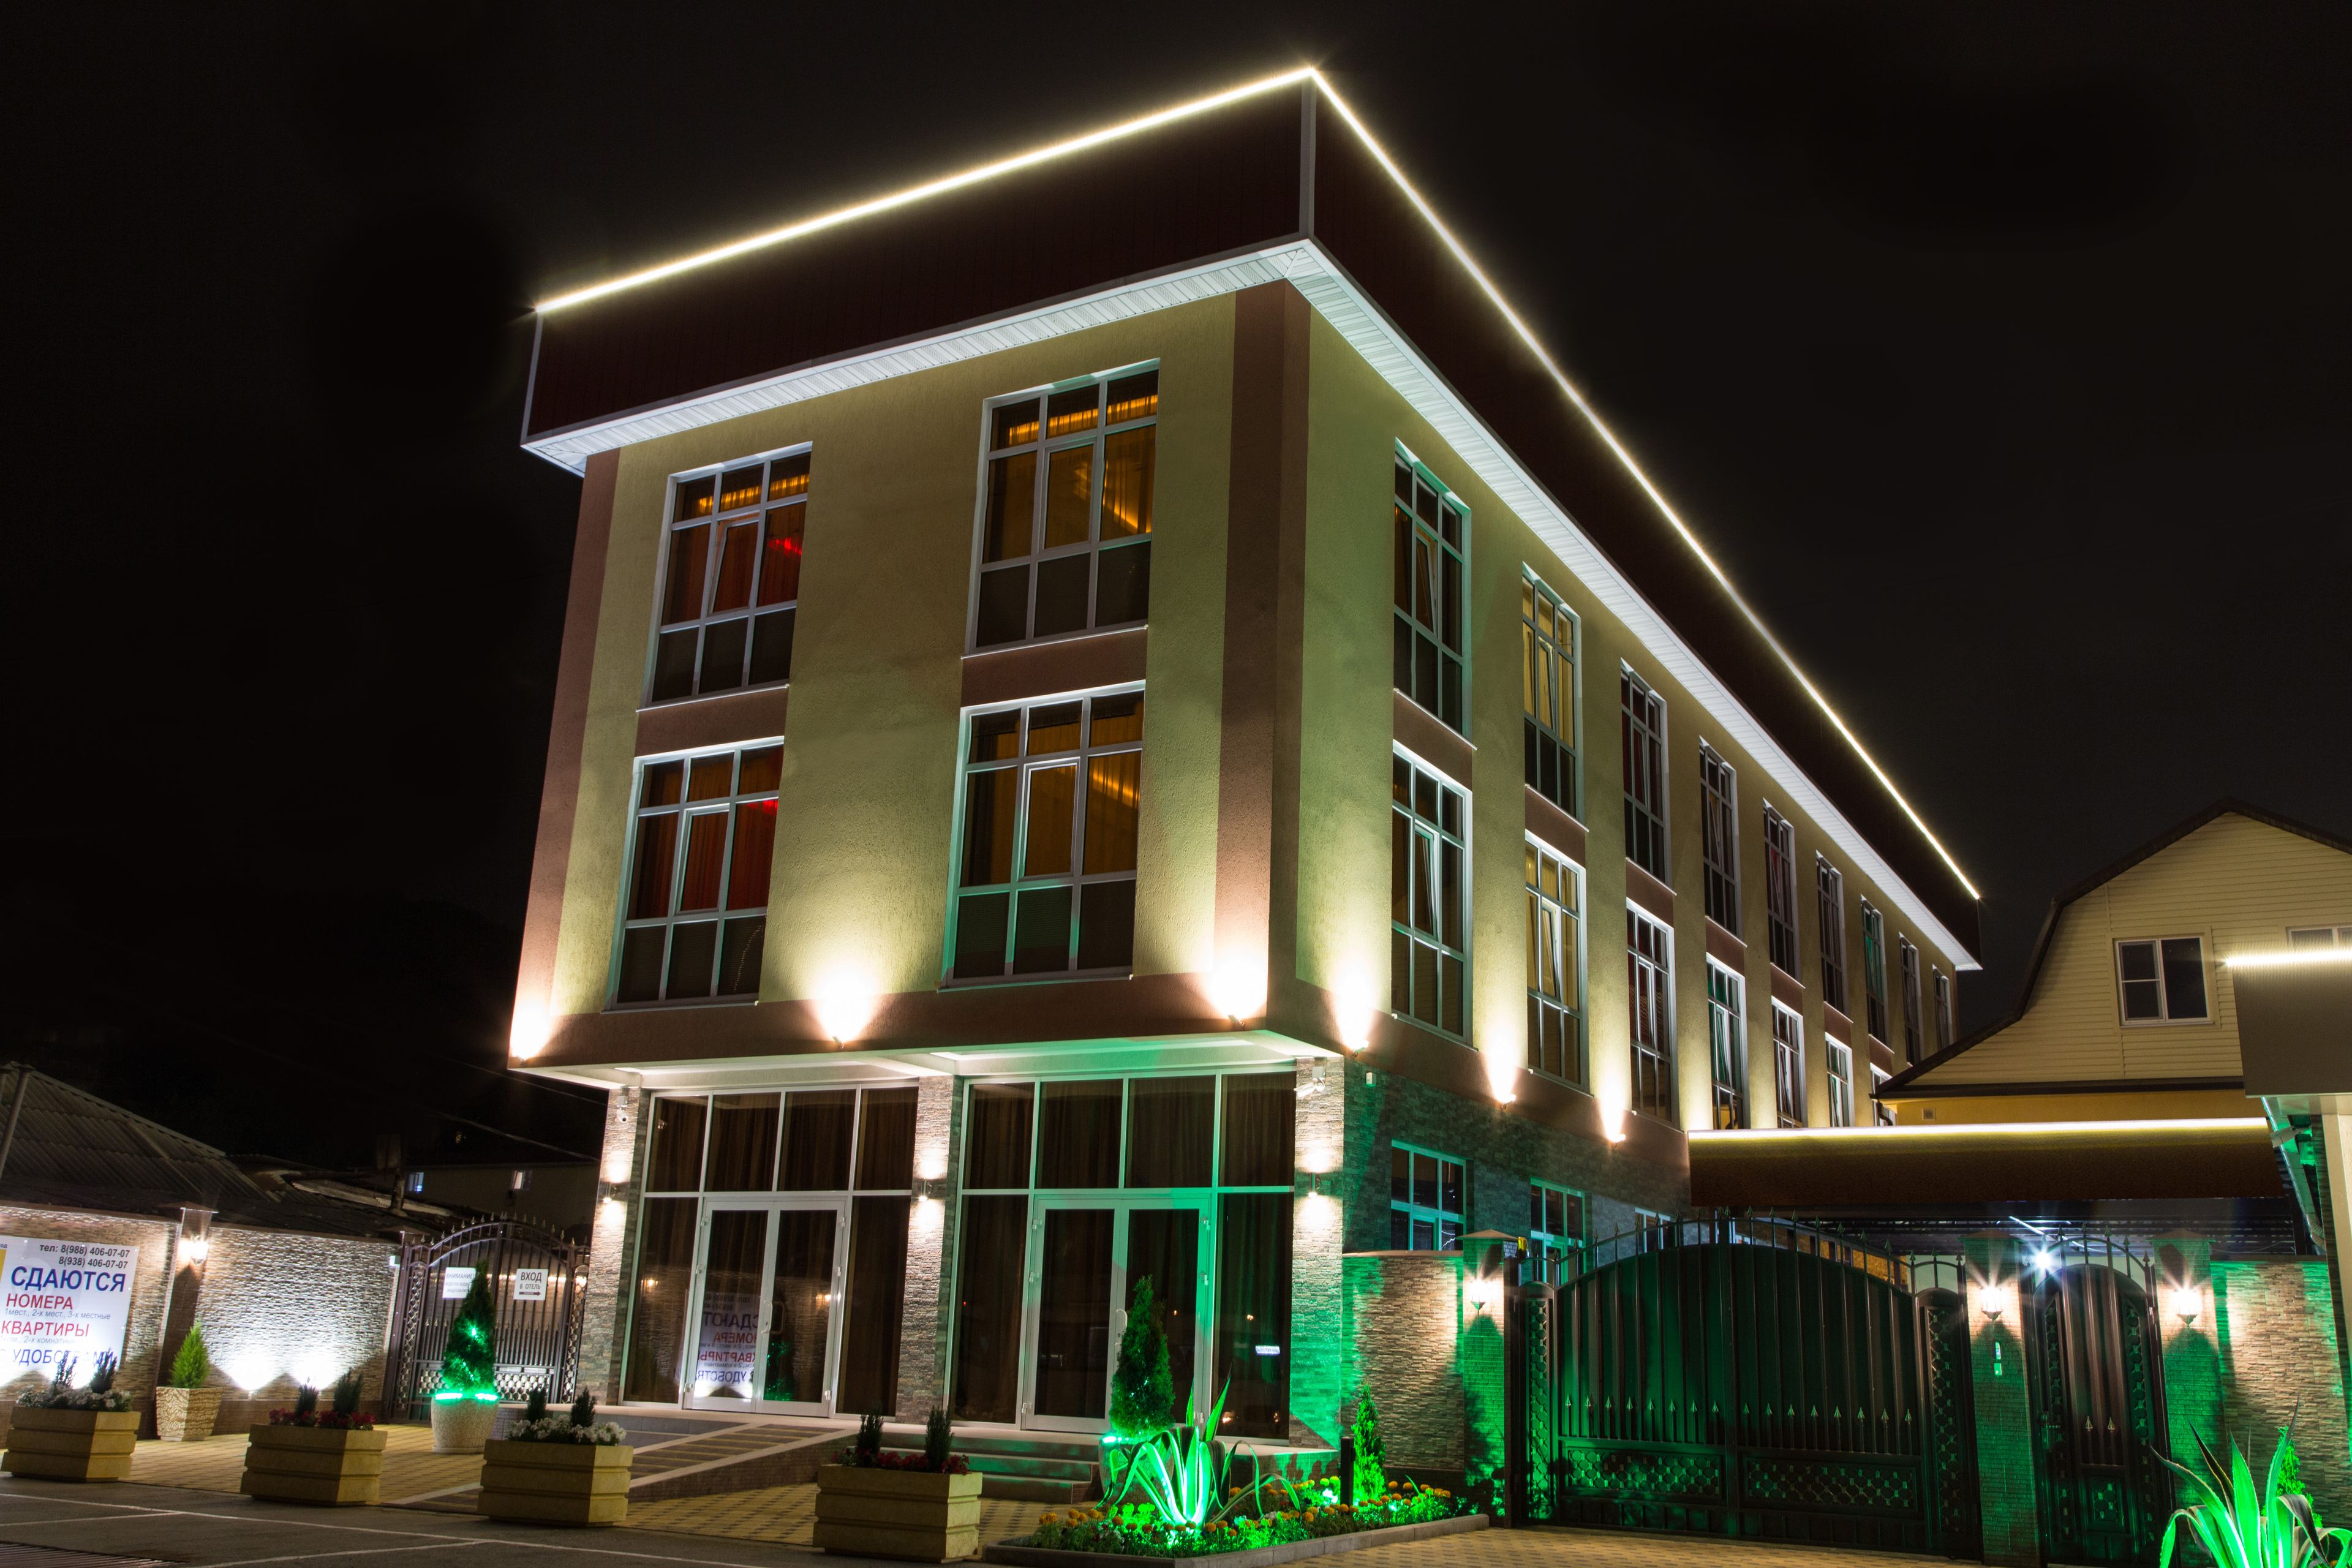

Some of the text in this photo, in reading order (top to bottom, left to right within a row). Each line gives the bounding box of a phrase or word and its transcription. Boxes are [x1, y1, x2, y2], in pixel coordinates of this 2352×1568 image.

[61, 1245, 88, 1257] 8(988)
[89, 1247, 130, 1258] 406-07-07
[59, 1256, 129, 1269] 8(938) 406-07-07
[11, 1266, 126, 1292] СДАЮТСЯ
[521, 1272, 542, 1283] ВХОД
[6, 1293, 73, 1310] НОМЕРА
[1, 1320, 89, 1337] КВАРТИРЫ
